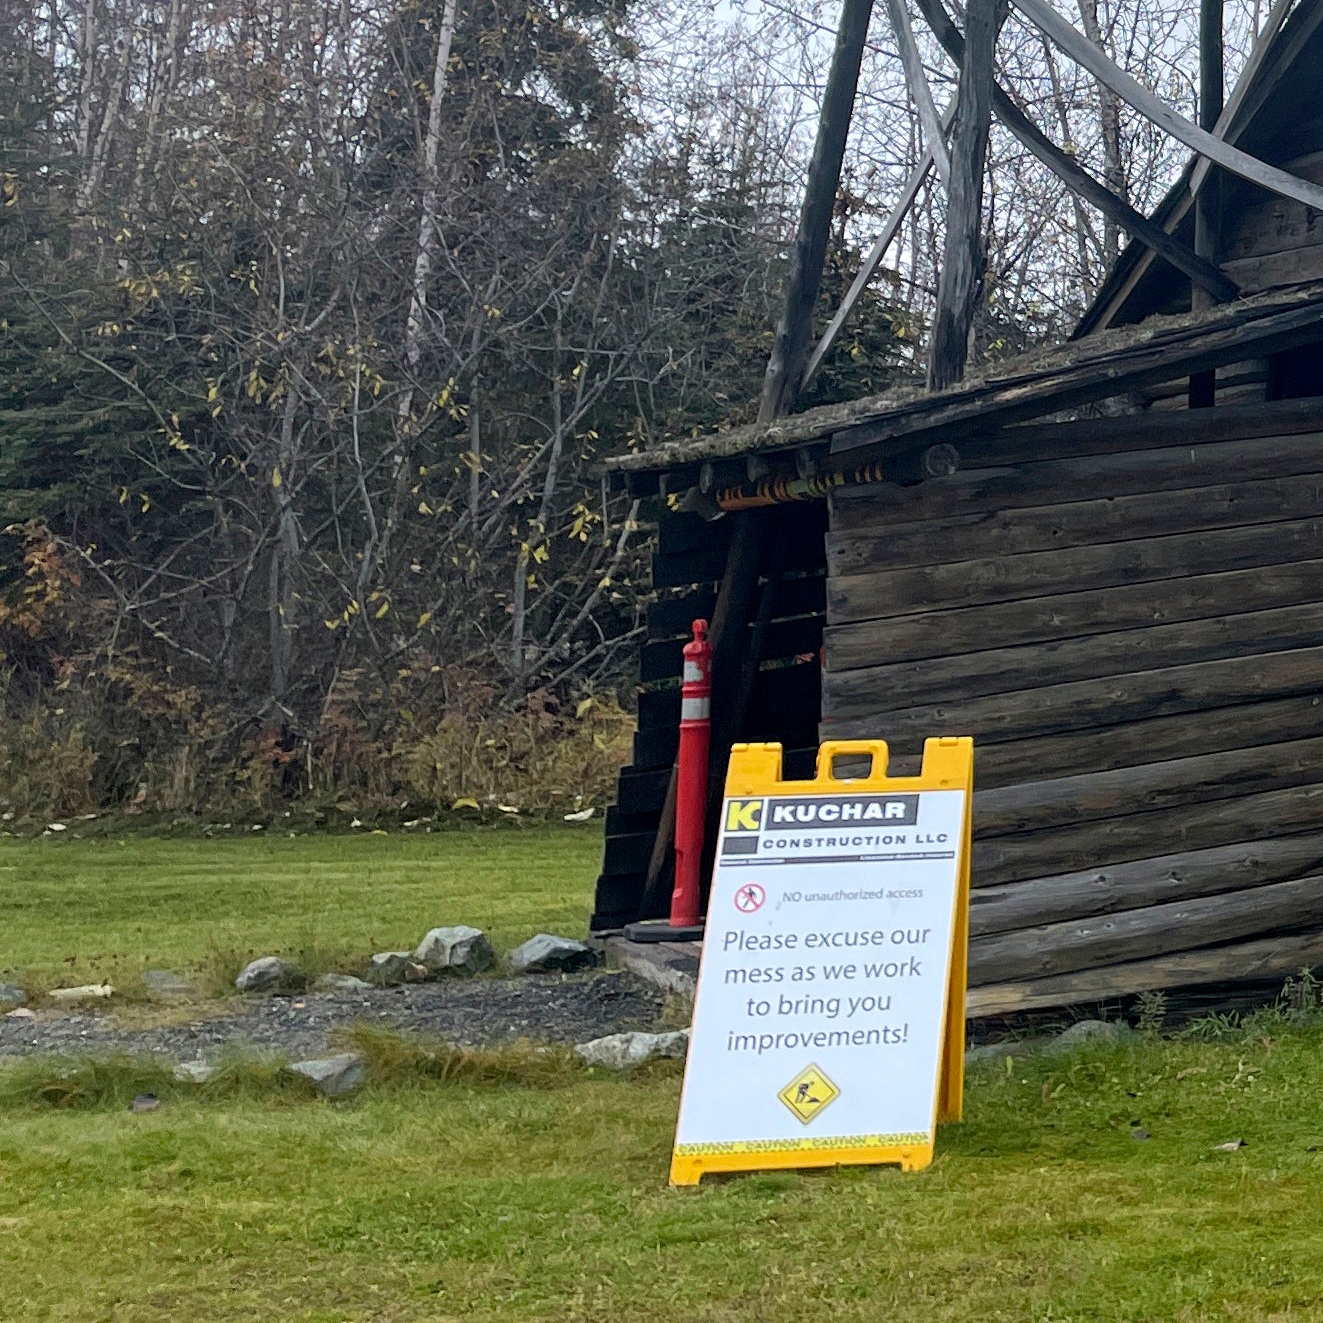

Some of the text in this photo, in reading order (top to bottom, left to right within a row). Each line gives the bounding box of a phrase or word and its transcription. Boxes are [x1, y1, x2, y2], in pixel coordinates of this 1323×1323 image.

[773, 802, 906, 823] KUCHAR
[763, 833, 949, 849] CONSTRUCTION LLC
[782, 888, 924, 903] NO unauthorized access
[723, 928, 931, 952] Please excuse our
[724, 956, 923, 984] mess as we work
[746, 994, 891, 1019] to bring you
[727, 1023, 909, 1055] improvements!
[679, 1143, 734, 1153] CAUTION
[746, 1140, 800, 1151] CAUTION
[812, 1137, 867, 1147] CAUTION
